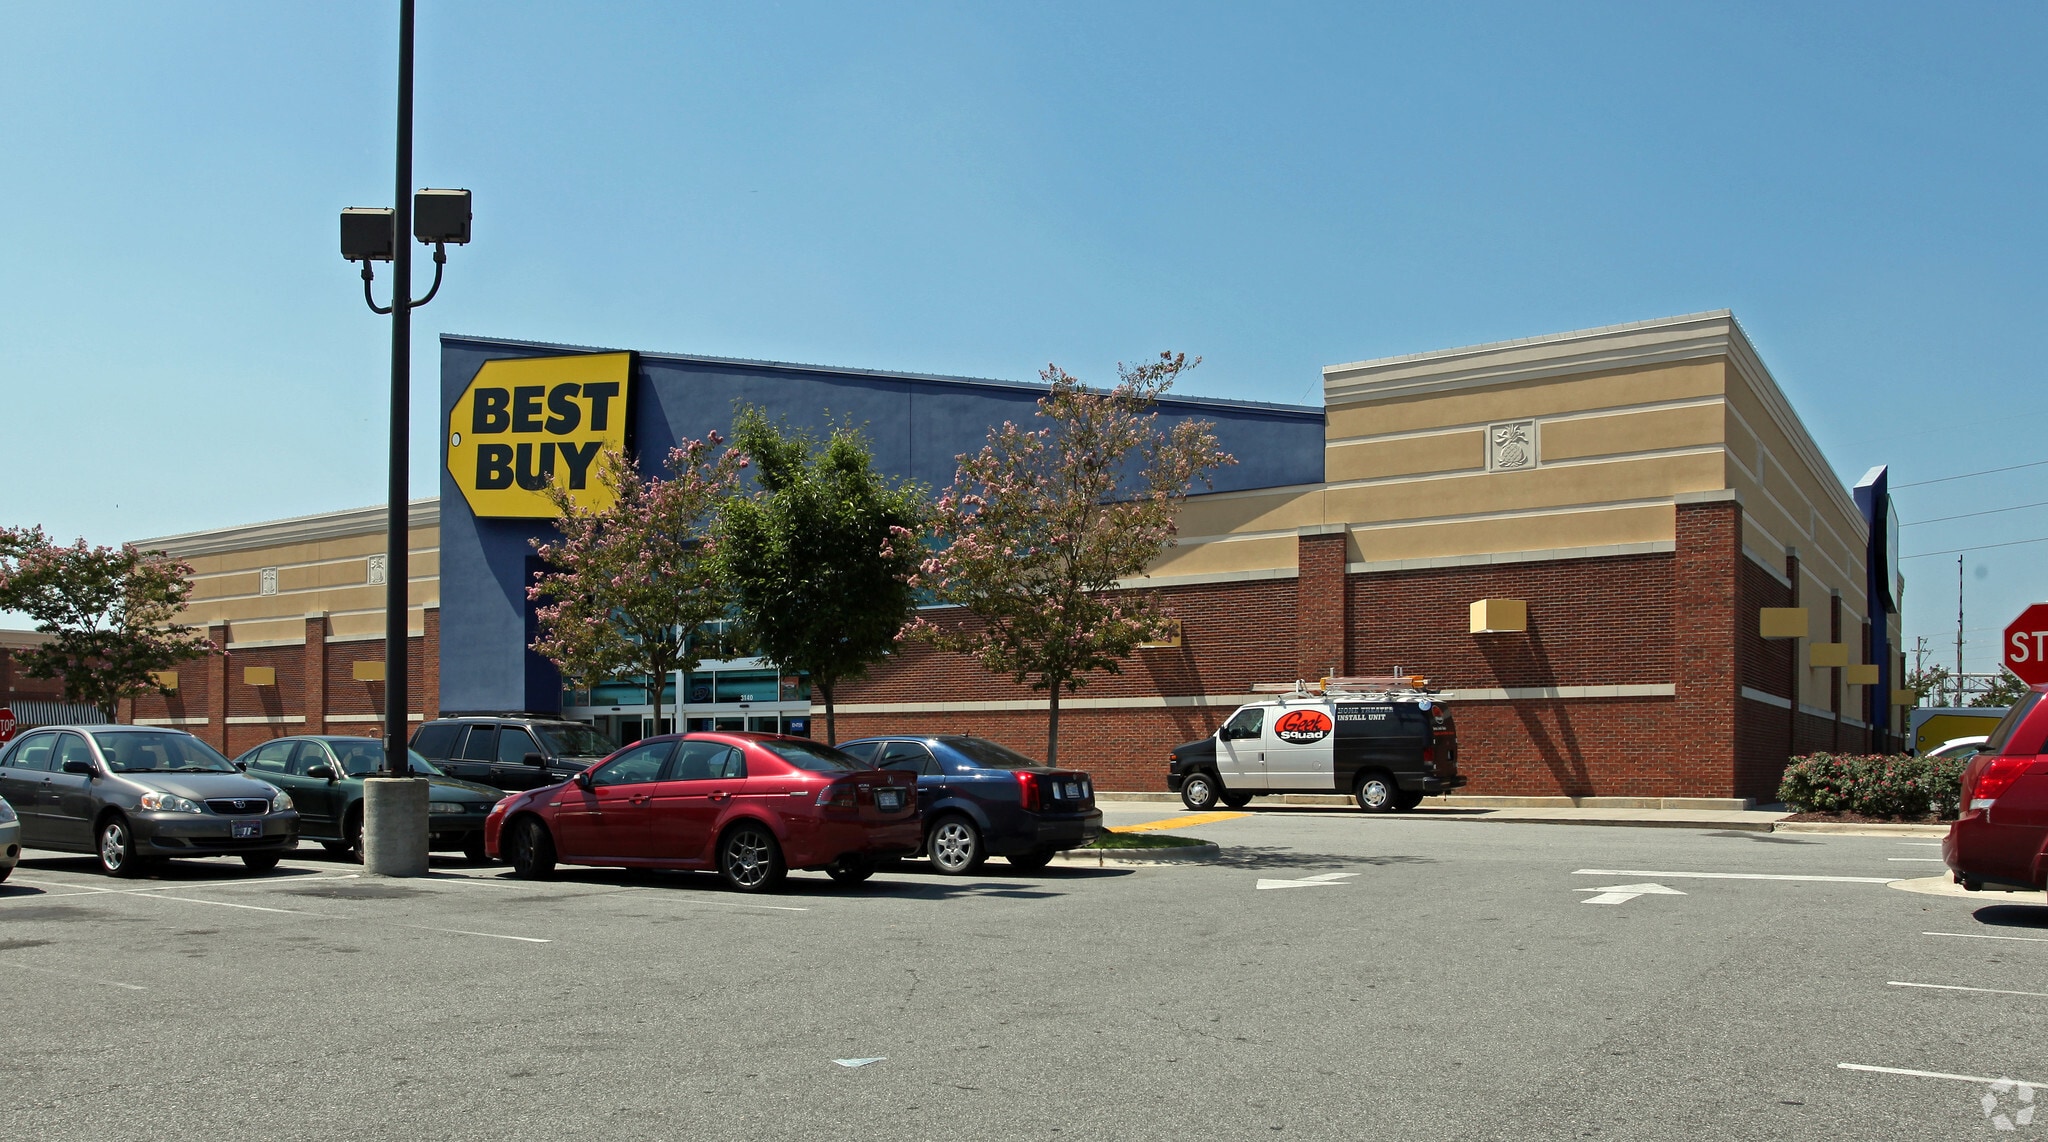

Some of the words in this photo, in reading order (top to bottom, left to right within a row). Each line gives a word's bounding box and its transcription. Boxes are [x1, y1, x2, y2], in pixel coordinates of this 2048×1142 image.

[472, 382, 619, 435] BEST
[476, 442, 603, 491] BUY
[740, 694, 754, 702] 3140
[0, 719, 15, 732] TOP
[1283, 711, 1322, 732] Geek
